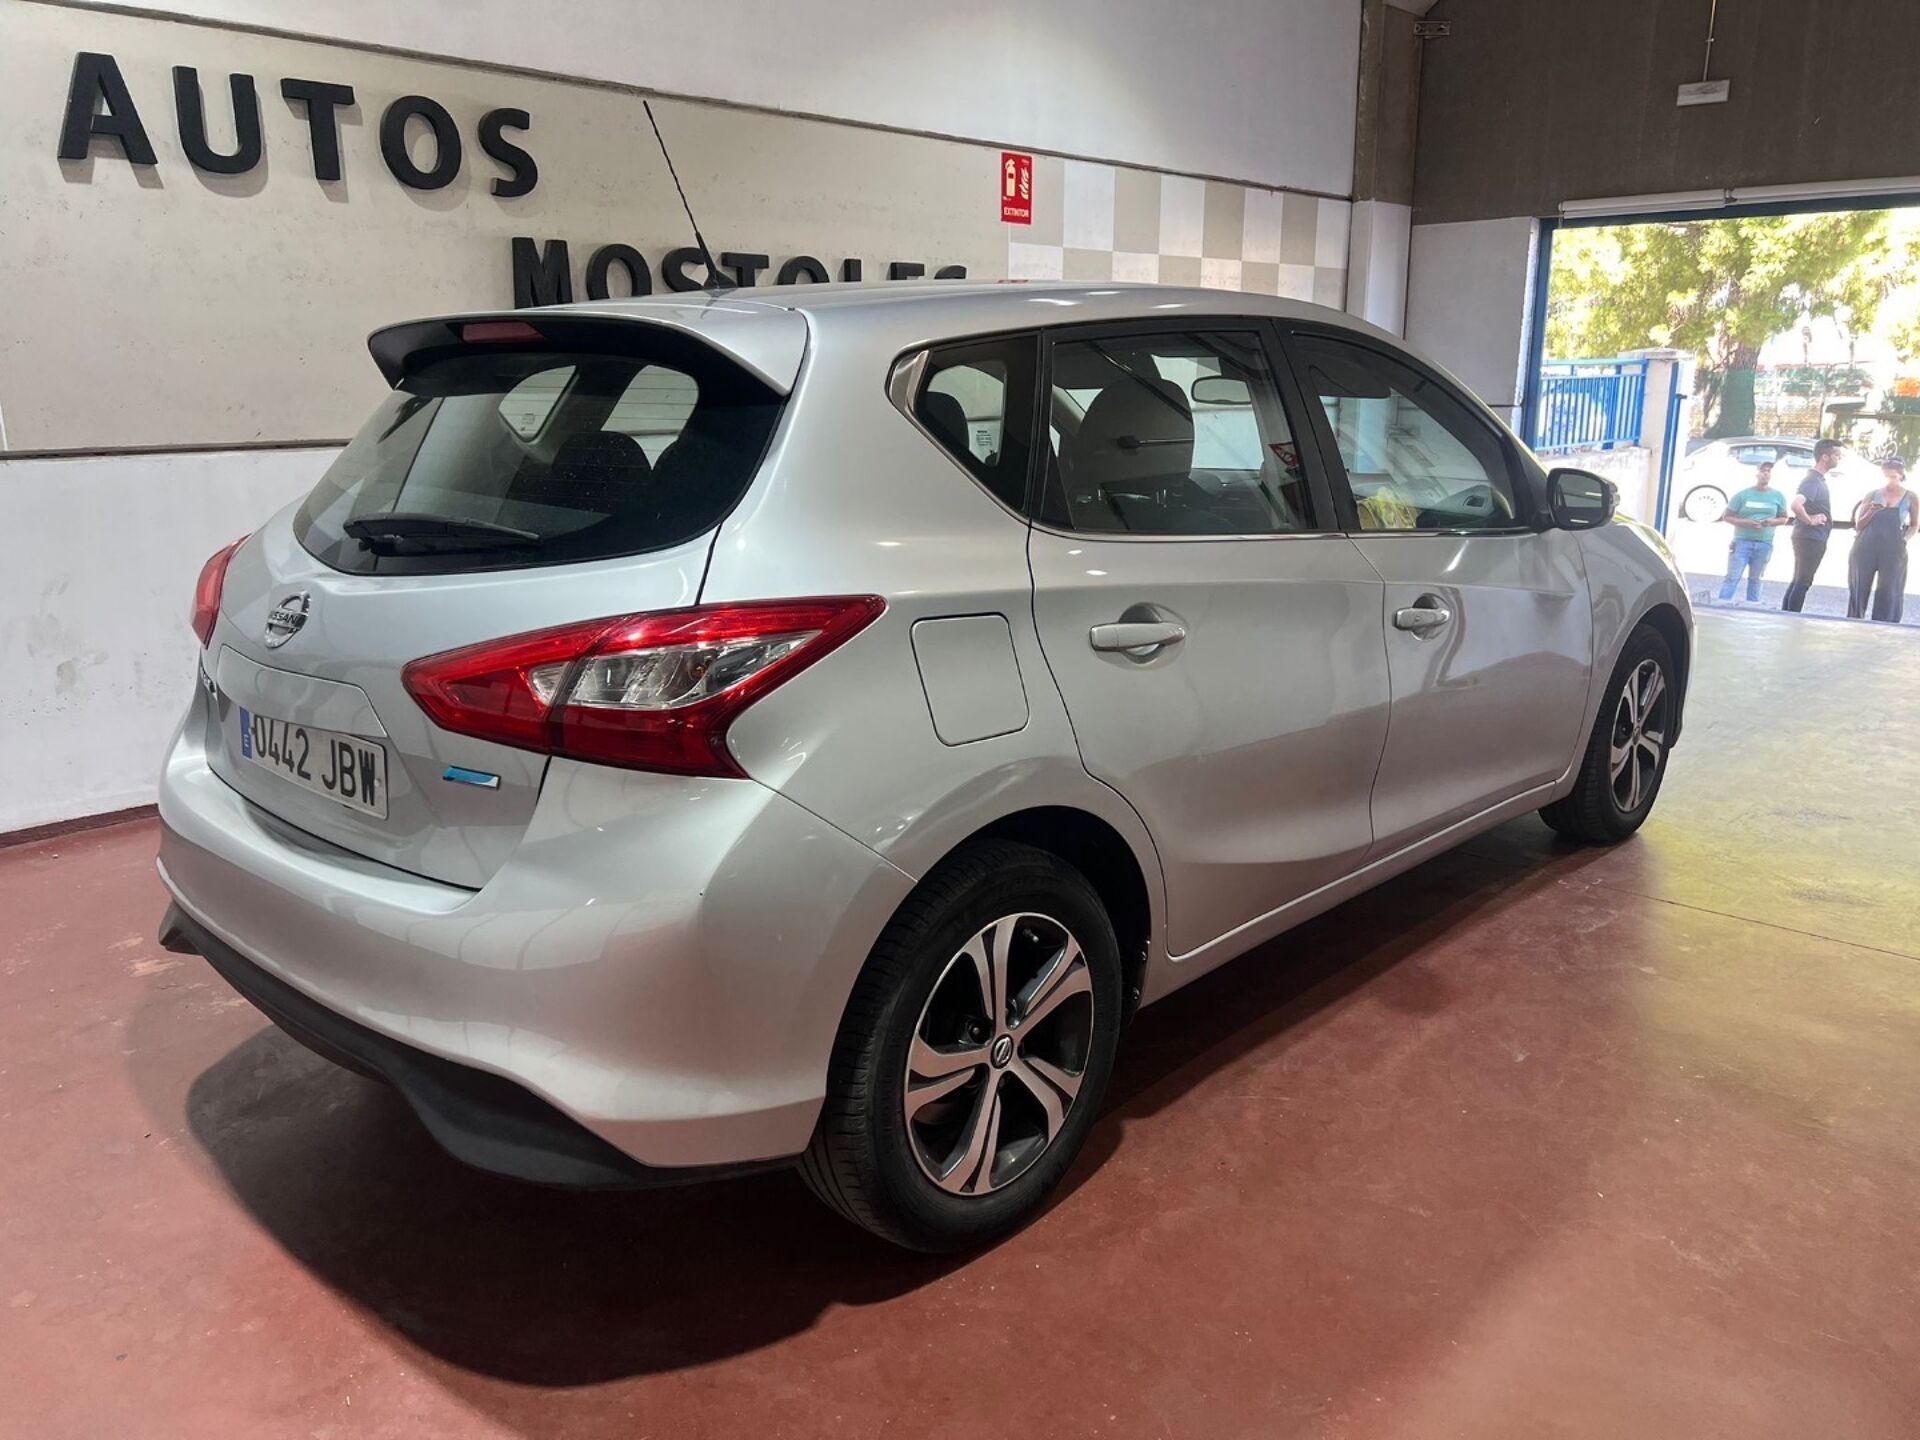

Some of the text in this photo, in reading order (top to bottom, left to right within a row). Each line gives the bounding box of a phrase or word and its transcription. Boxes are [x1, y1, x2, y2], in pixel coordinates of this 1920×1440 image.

[58, 52, 538, 198] AUTOS
[511, 236, 967, 309] MOST
[253, 713, 311, 781] 0442
[321, 738, 376, 807] JBW
